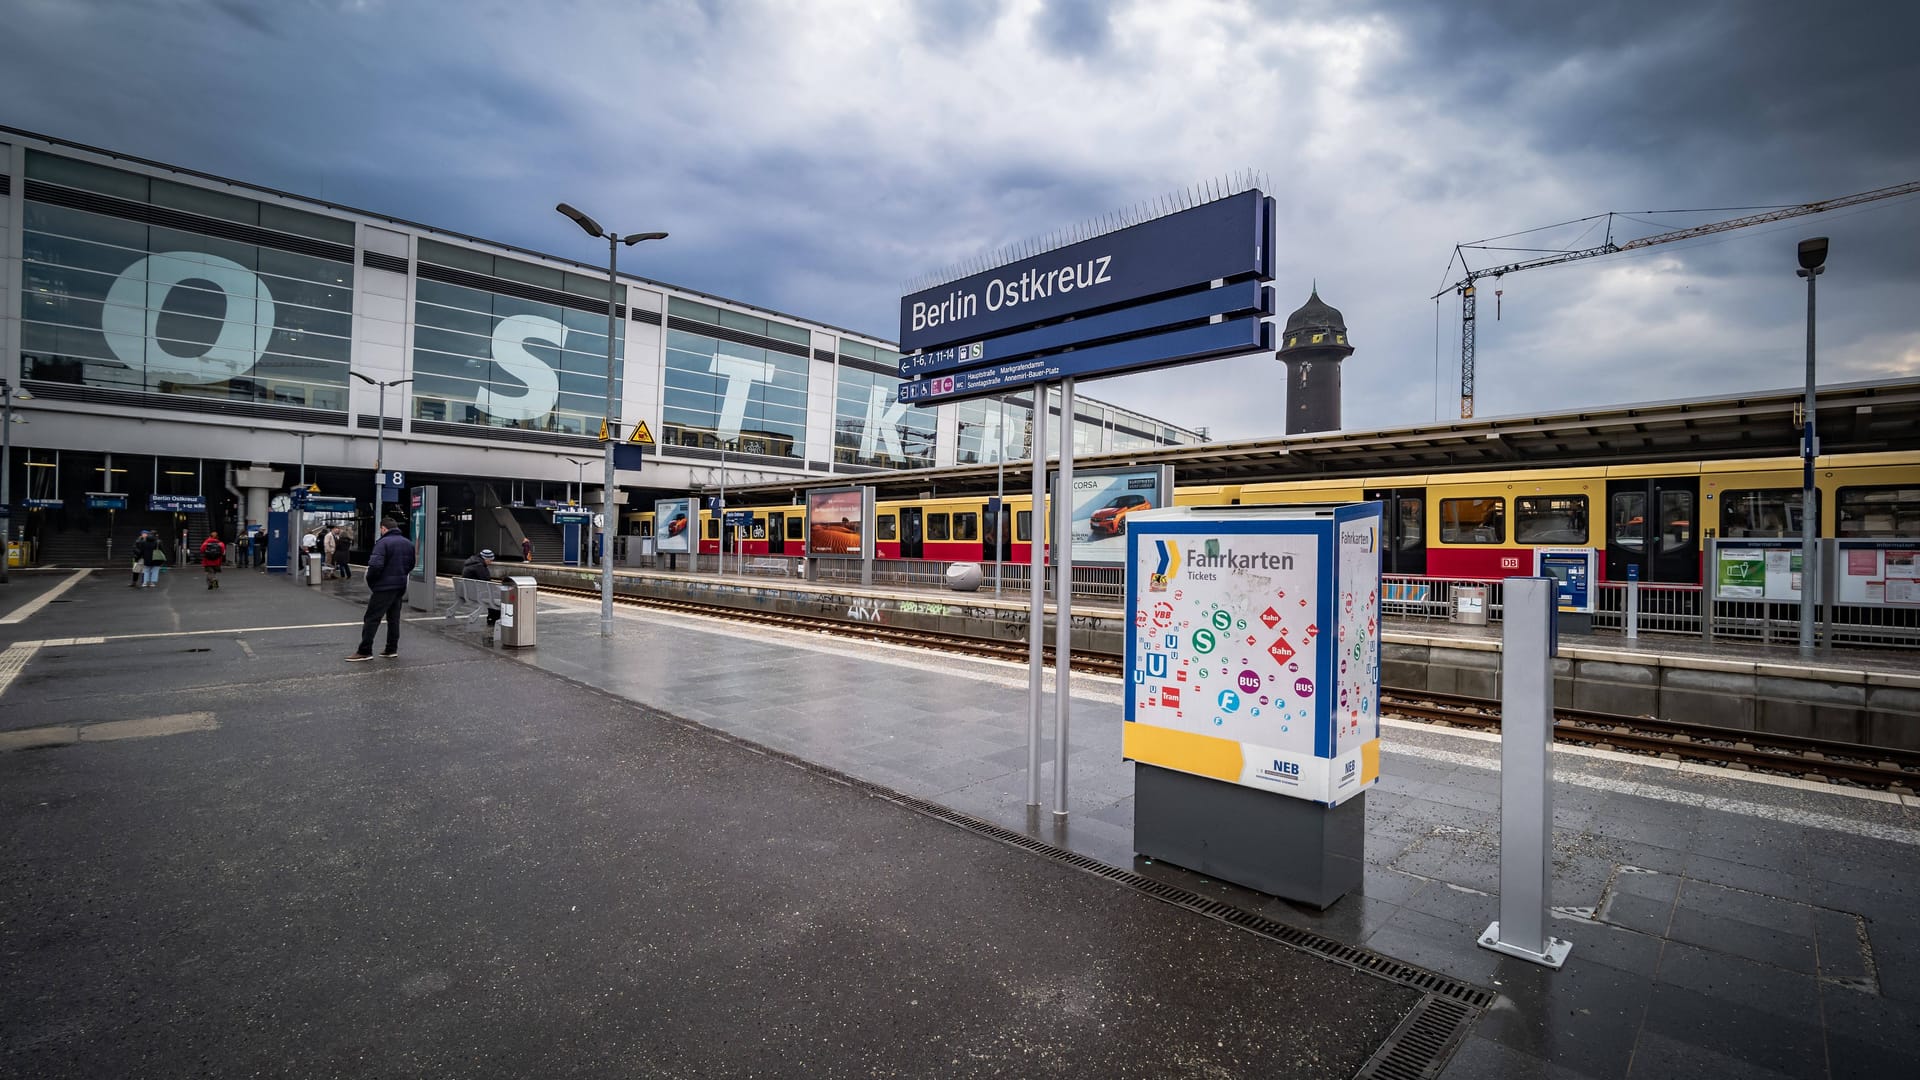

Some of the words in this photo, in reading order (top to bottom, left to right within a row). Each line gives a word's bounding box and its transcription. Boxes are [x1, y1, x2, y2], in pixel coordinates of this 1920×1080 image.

[911, 290, 977, 332] Berlin
[985, 255, 1112, 312] Ostkreuz
[936, 348, 954, 362] 11-14
[967, 369, 996, 380] Hauptstraße
[1000, 360, 1045, 375] Markgrafendamm
[967, 377, 1001, 389] Sonntagstraße
[392, 471, 403, 485] 8
[1073, 480, 1098, 490] CORSA
[709, 497, 716, 507] 7
[1341, 530, 1369, 545] Fahrkarten
[1187, 548, 1294, 570] Fahrkarten
[1503, 559, 1517, 567] DB
[1187, 571, 1217, 581] Tickets
[1154, 610, 1171, 619] VBB
[1214, 611, 1229, 629] S
[1262, 614, 1279, 622] Bahn
[1238, 620, 1246, 629] S
[1166, 635, 1177, 648] U
[1195, 630, 1213, 652] S
[1271, 646, 1292, 656] Bahn
[1149, 654, 1165, 676] U
[1134, 670, 1144, 683] U
[1199, 669, 1208, 678] S
[1239, 676, 1260, 687] BUS
[1295, 683, 1313, 693] BUS
[1162, 691, 1179, 702] Tram
[1220, 691, 1237, 711] F
[1273, 759, 1300, 775] NEB
[1344, 760, 1356, 774] NEB
